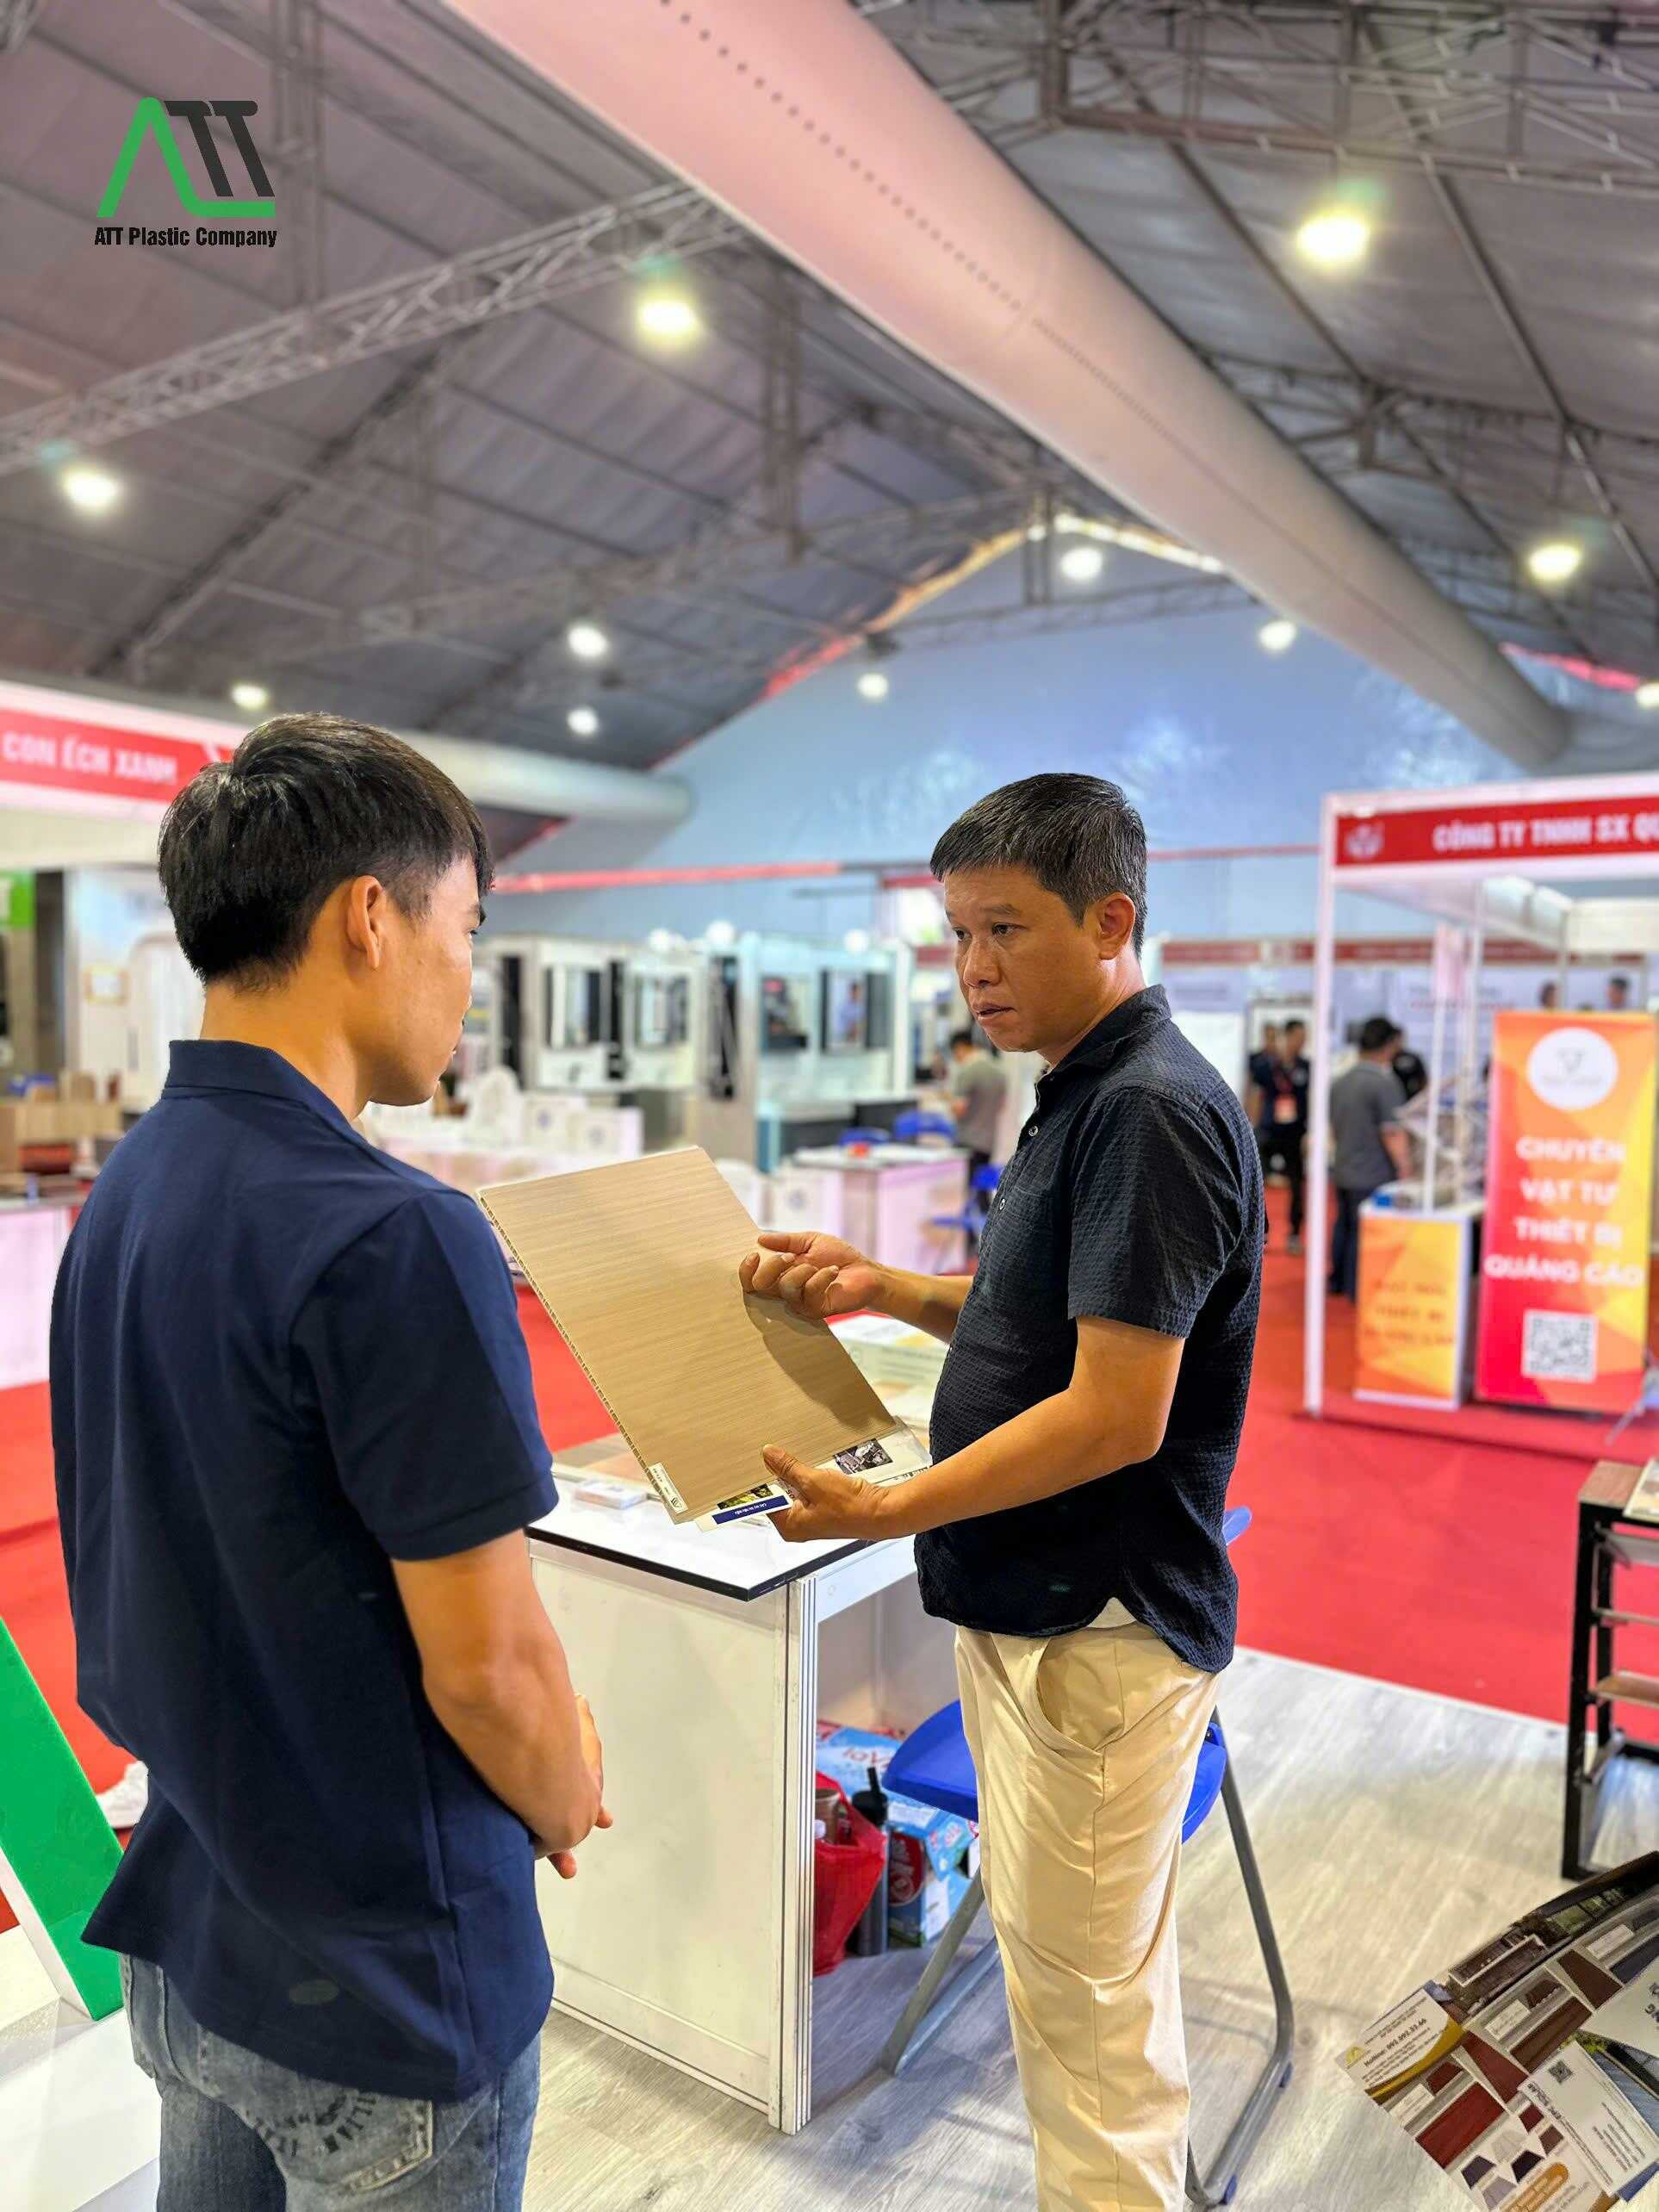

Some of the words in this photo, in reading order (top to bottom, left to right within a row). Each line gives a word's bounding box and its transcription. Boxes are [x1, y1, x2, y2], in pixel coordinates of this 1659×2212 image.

[3, 731, 56, 766] CON
[1432, 819, 1495, 852] CÔNG
[1500, 820, 1525, 848] TY
[1597, 814, 1629, 843] SX
